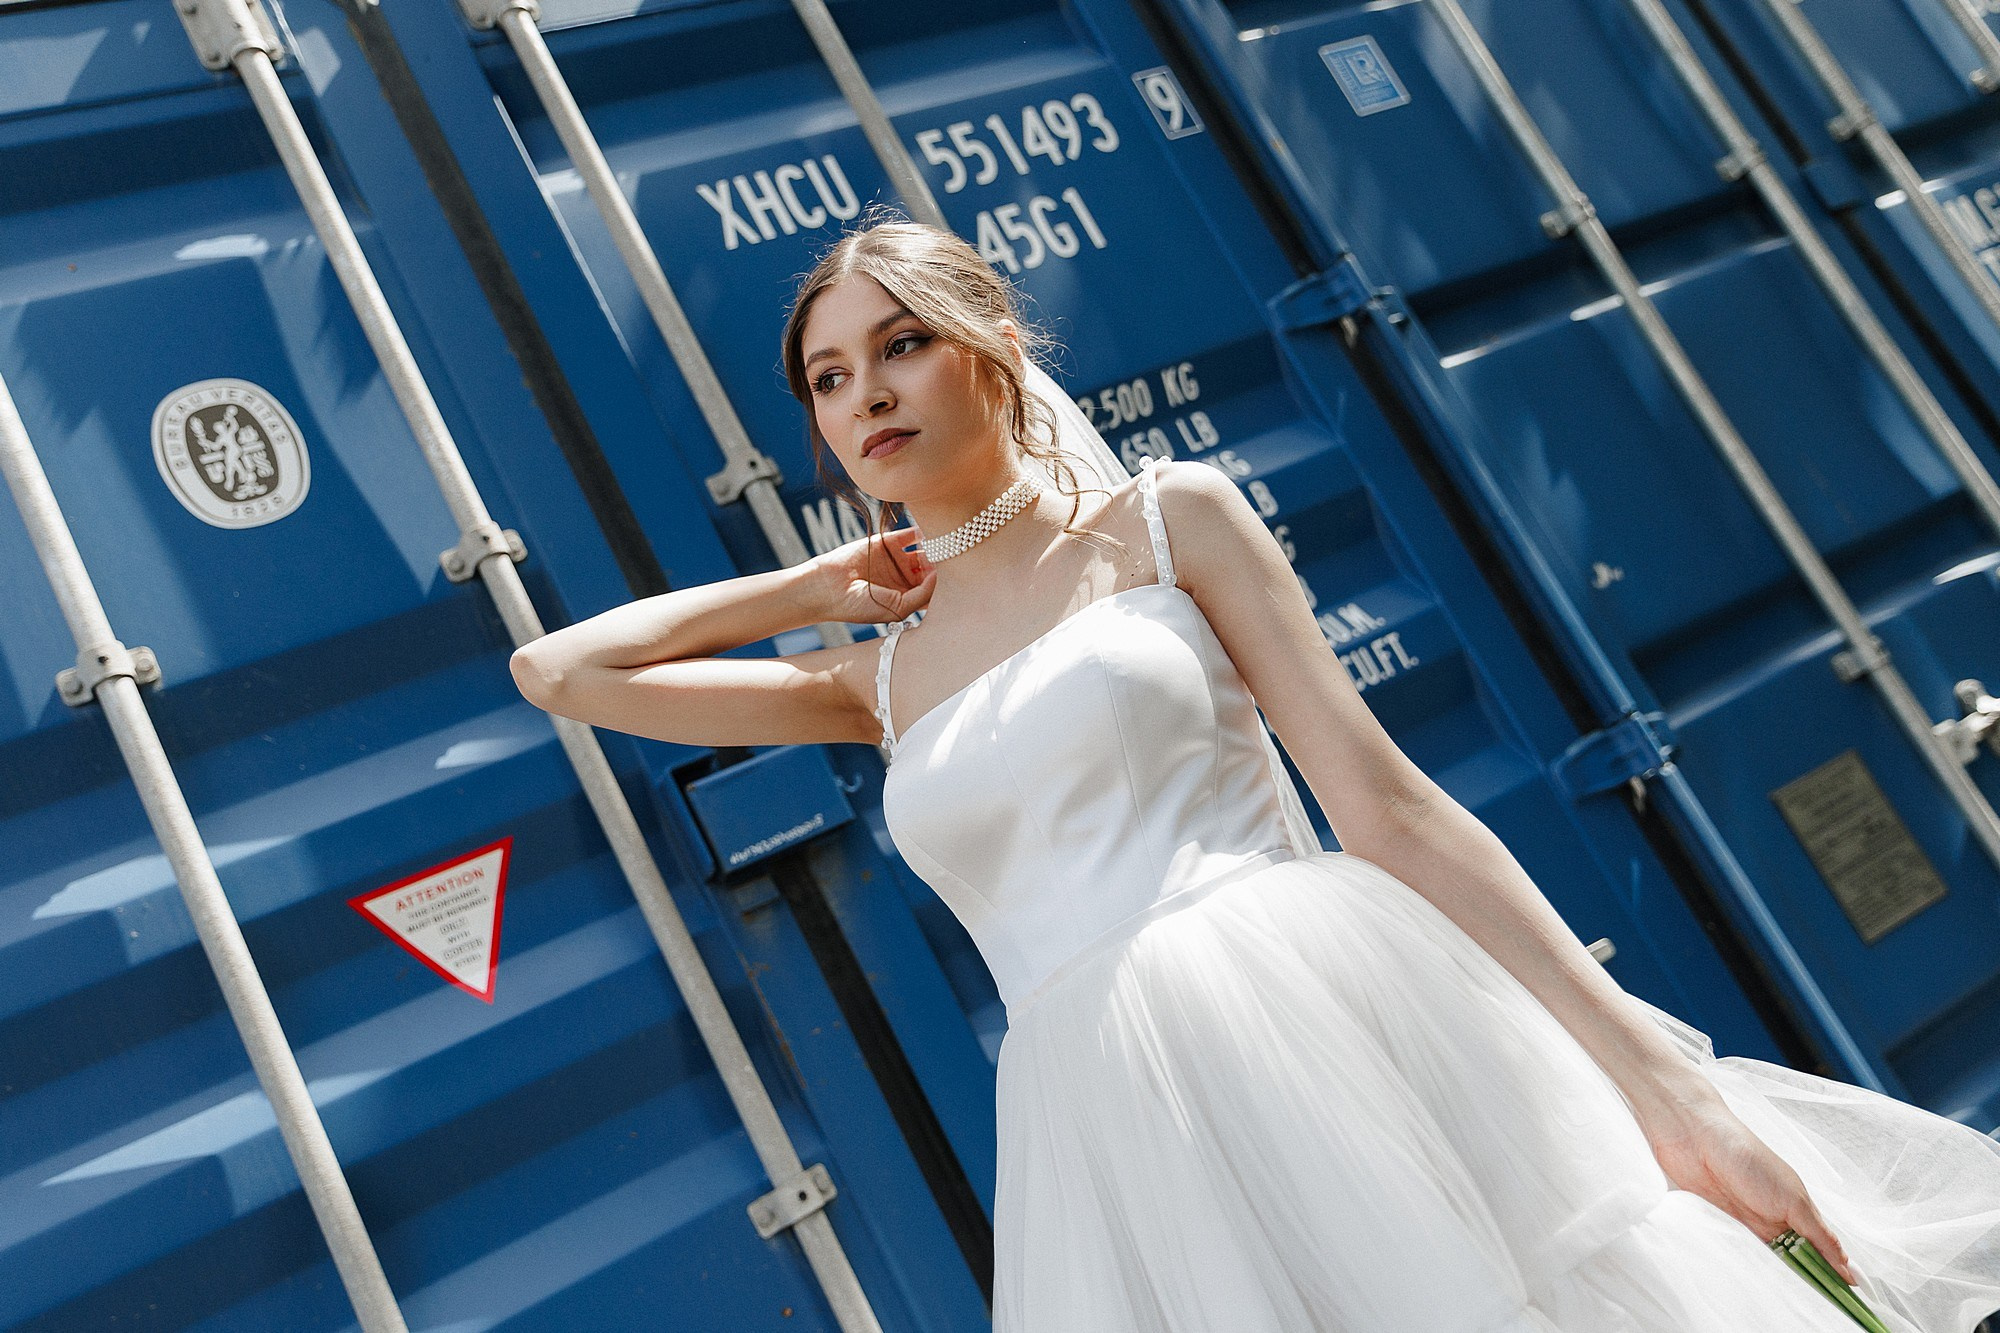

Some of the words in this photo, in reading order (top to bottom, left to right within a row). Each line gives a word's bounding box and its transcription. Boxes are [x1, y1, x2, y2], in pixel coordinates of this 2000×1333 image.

[696, 154, 861, 250] XHCU
[916, 93, 1120, 194] 551493
[1144, 74, 1184, 132] 9
[976, 186, 1108, 275] 45G1
[1160, 362, 1200, 409] KG
[167, 395, 202, 471] BUREAU
[1174, 410, 1221, 453] LB
[1249, 479, 1280, 520] B
[1274, 524, 1297, 563] G
[1317, 602, 1387, 650] U.M.
[395, 867, 485, 911] ATTENTION
